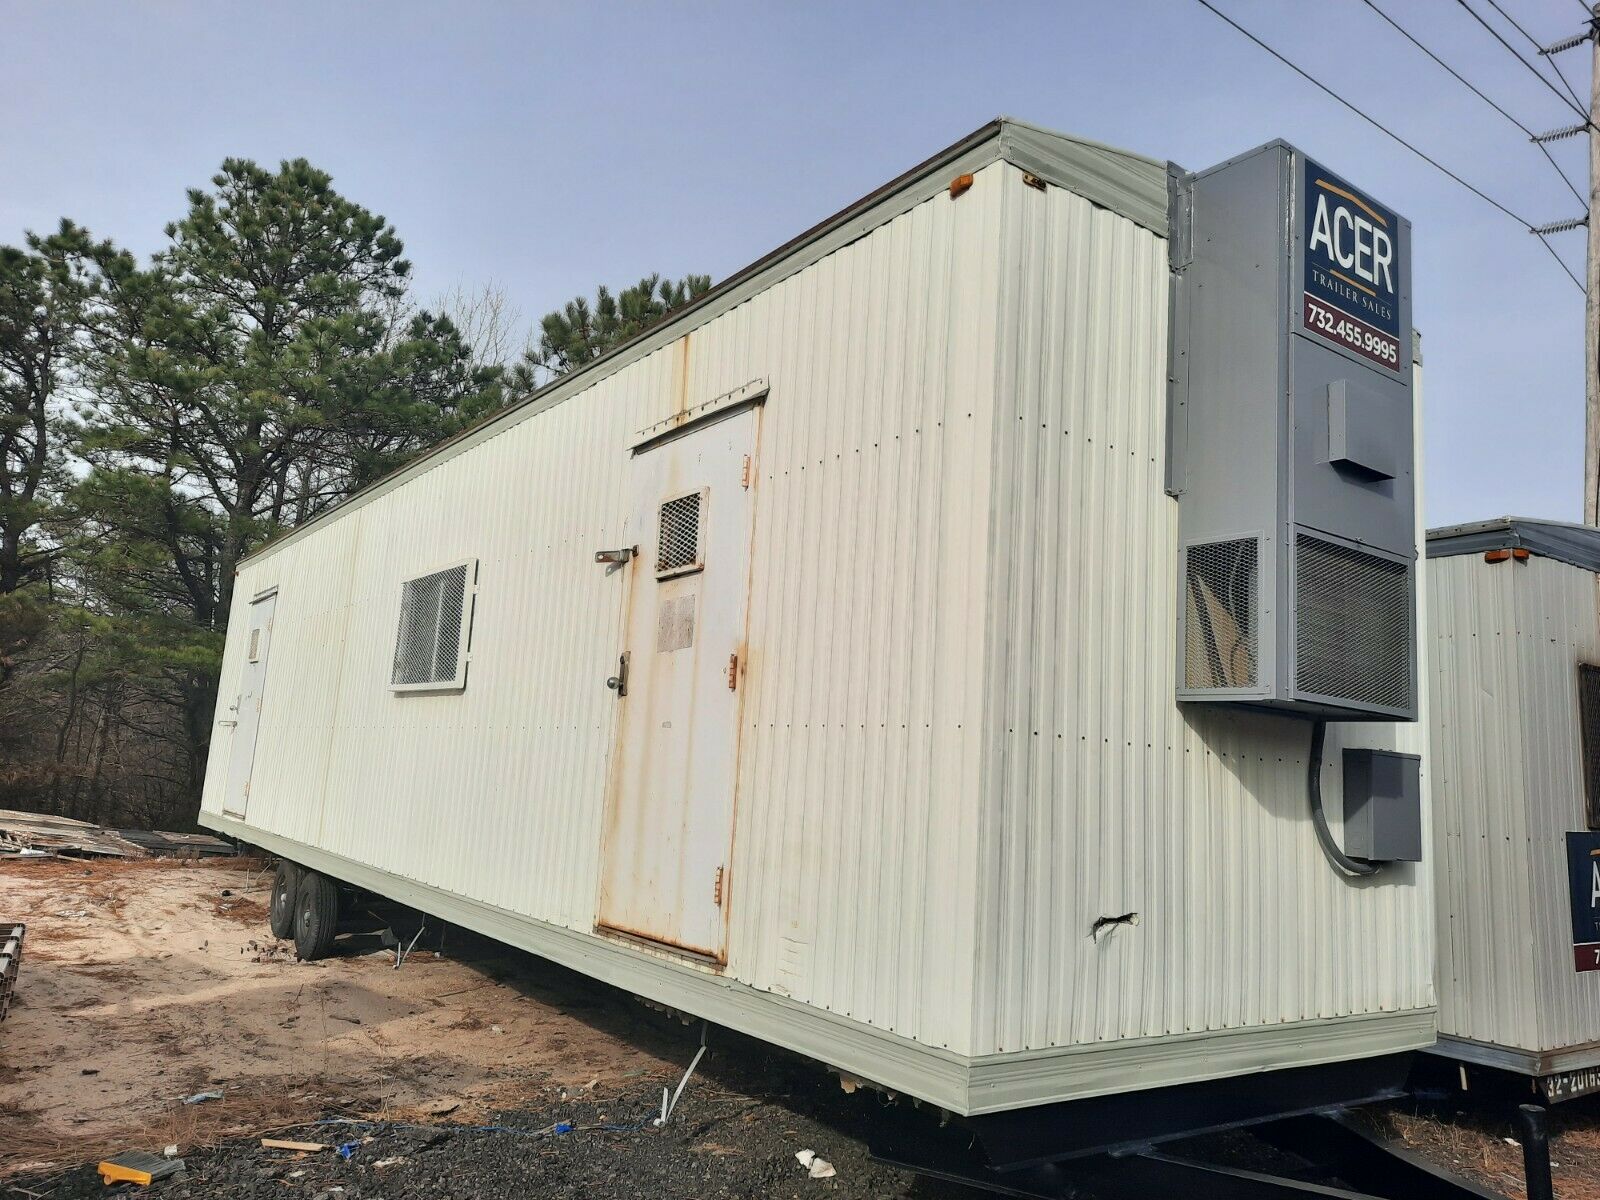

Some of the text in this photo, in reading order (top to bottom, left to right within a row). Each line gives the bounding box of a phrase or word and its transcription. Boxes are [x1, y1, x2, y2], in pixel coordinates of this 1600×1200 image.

[1309, 193, 1394, 294] ACER
[1312, 269, 1392, 321] TRAILER SALES
[1308, 303, 1397, 364] 732.455.9995
